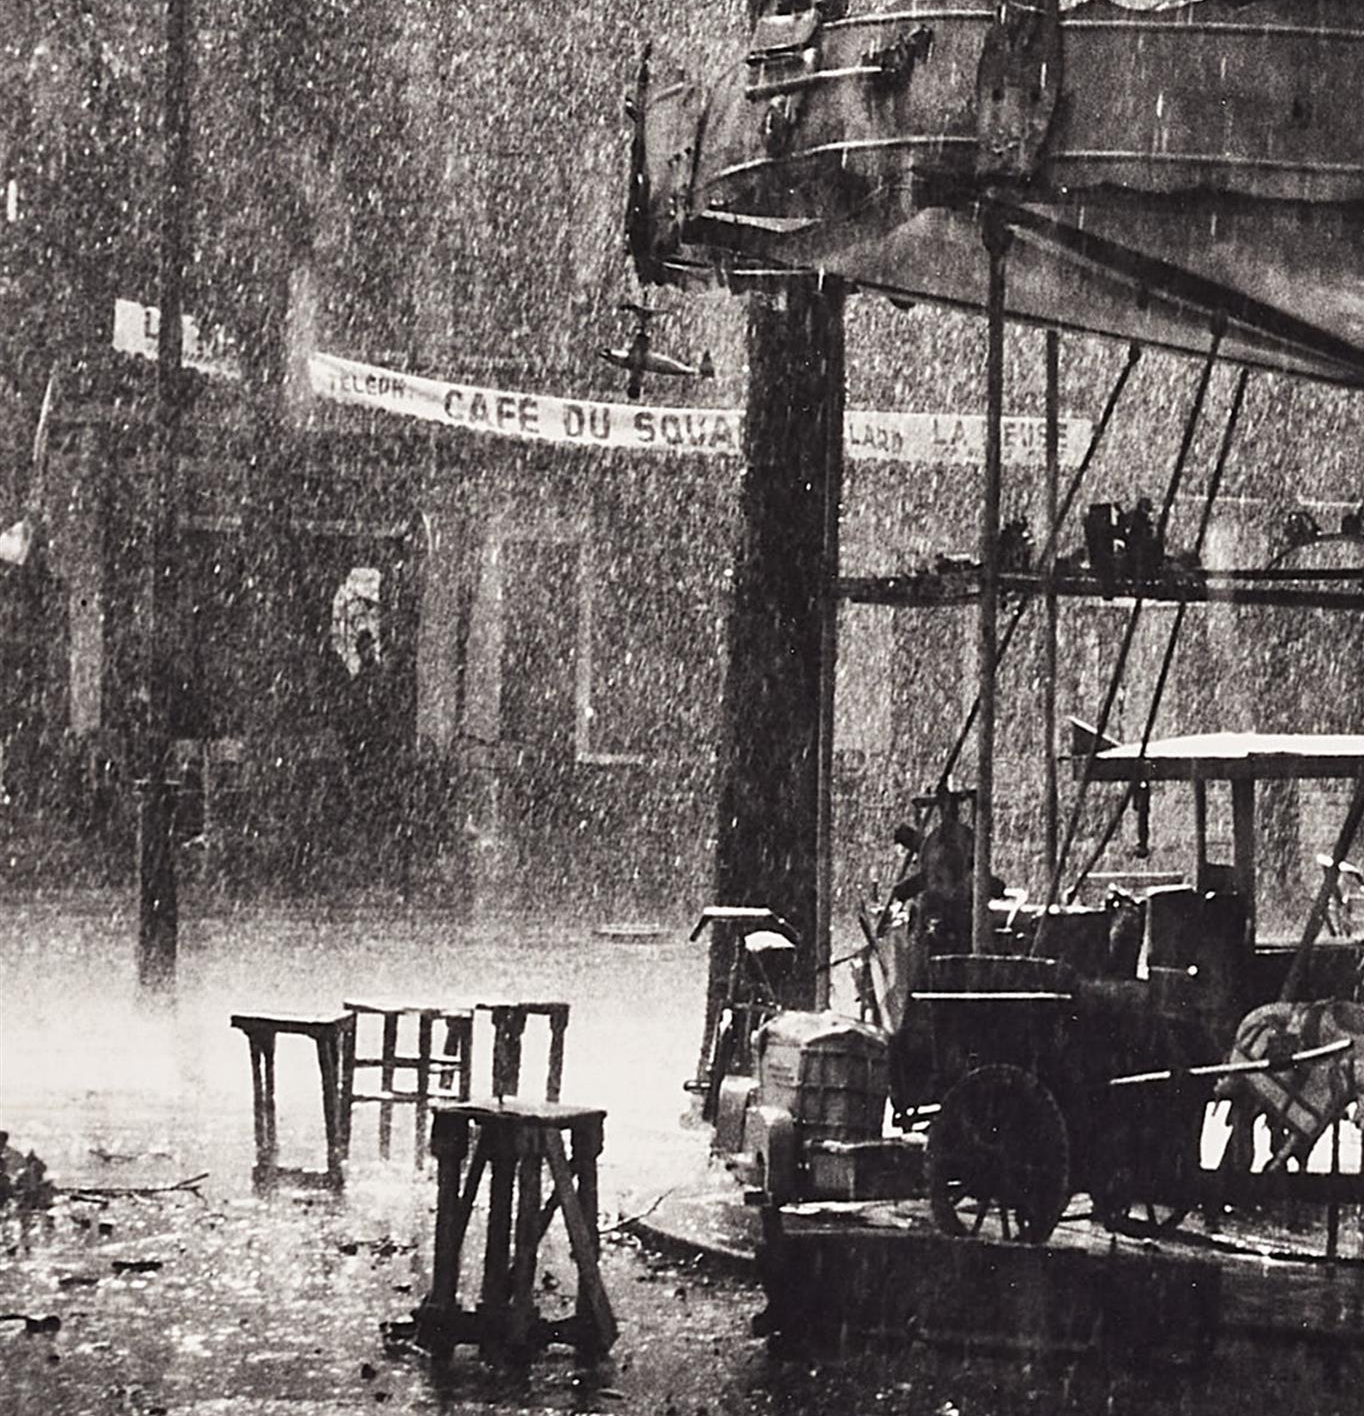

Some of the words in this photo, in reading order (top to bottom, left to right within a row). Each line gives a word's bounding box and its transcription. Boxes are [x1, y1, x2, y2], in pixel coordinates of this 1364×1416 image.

[563, 404, 611, 440] DU
[633, 412, 747, 450] SQUA
[933, 418, 968, 446] LA
[981, 419, 1067, 448] EUSE
